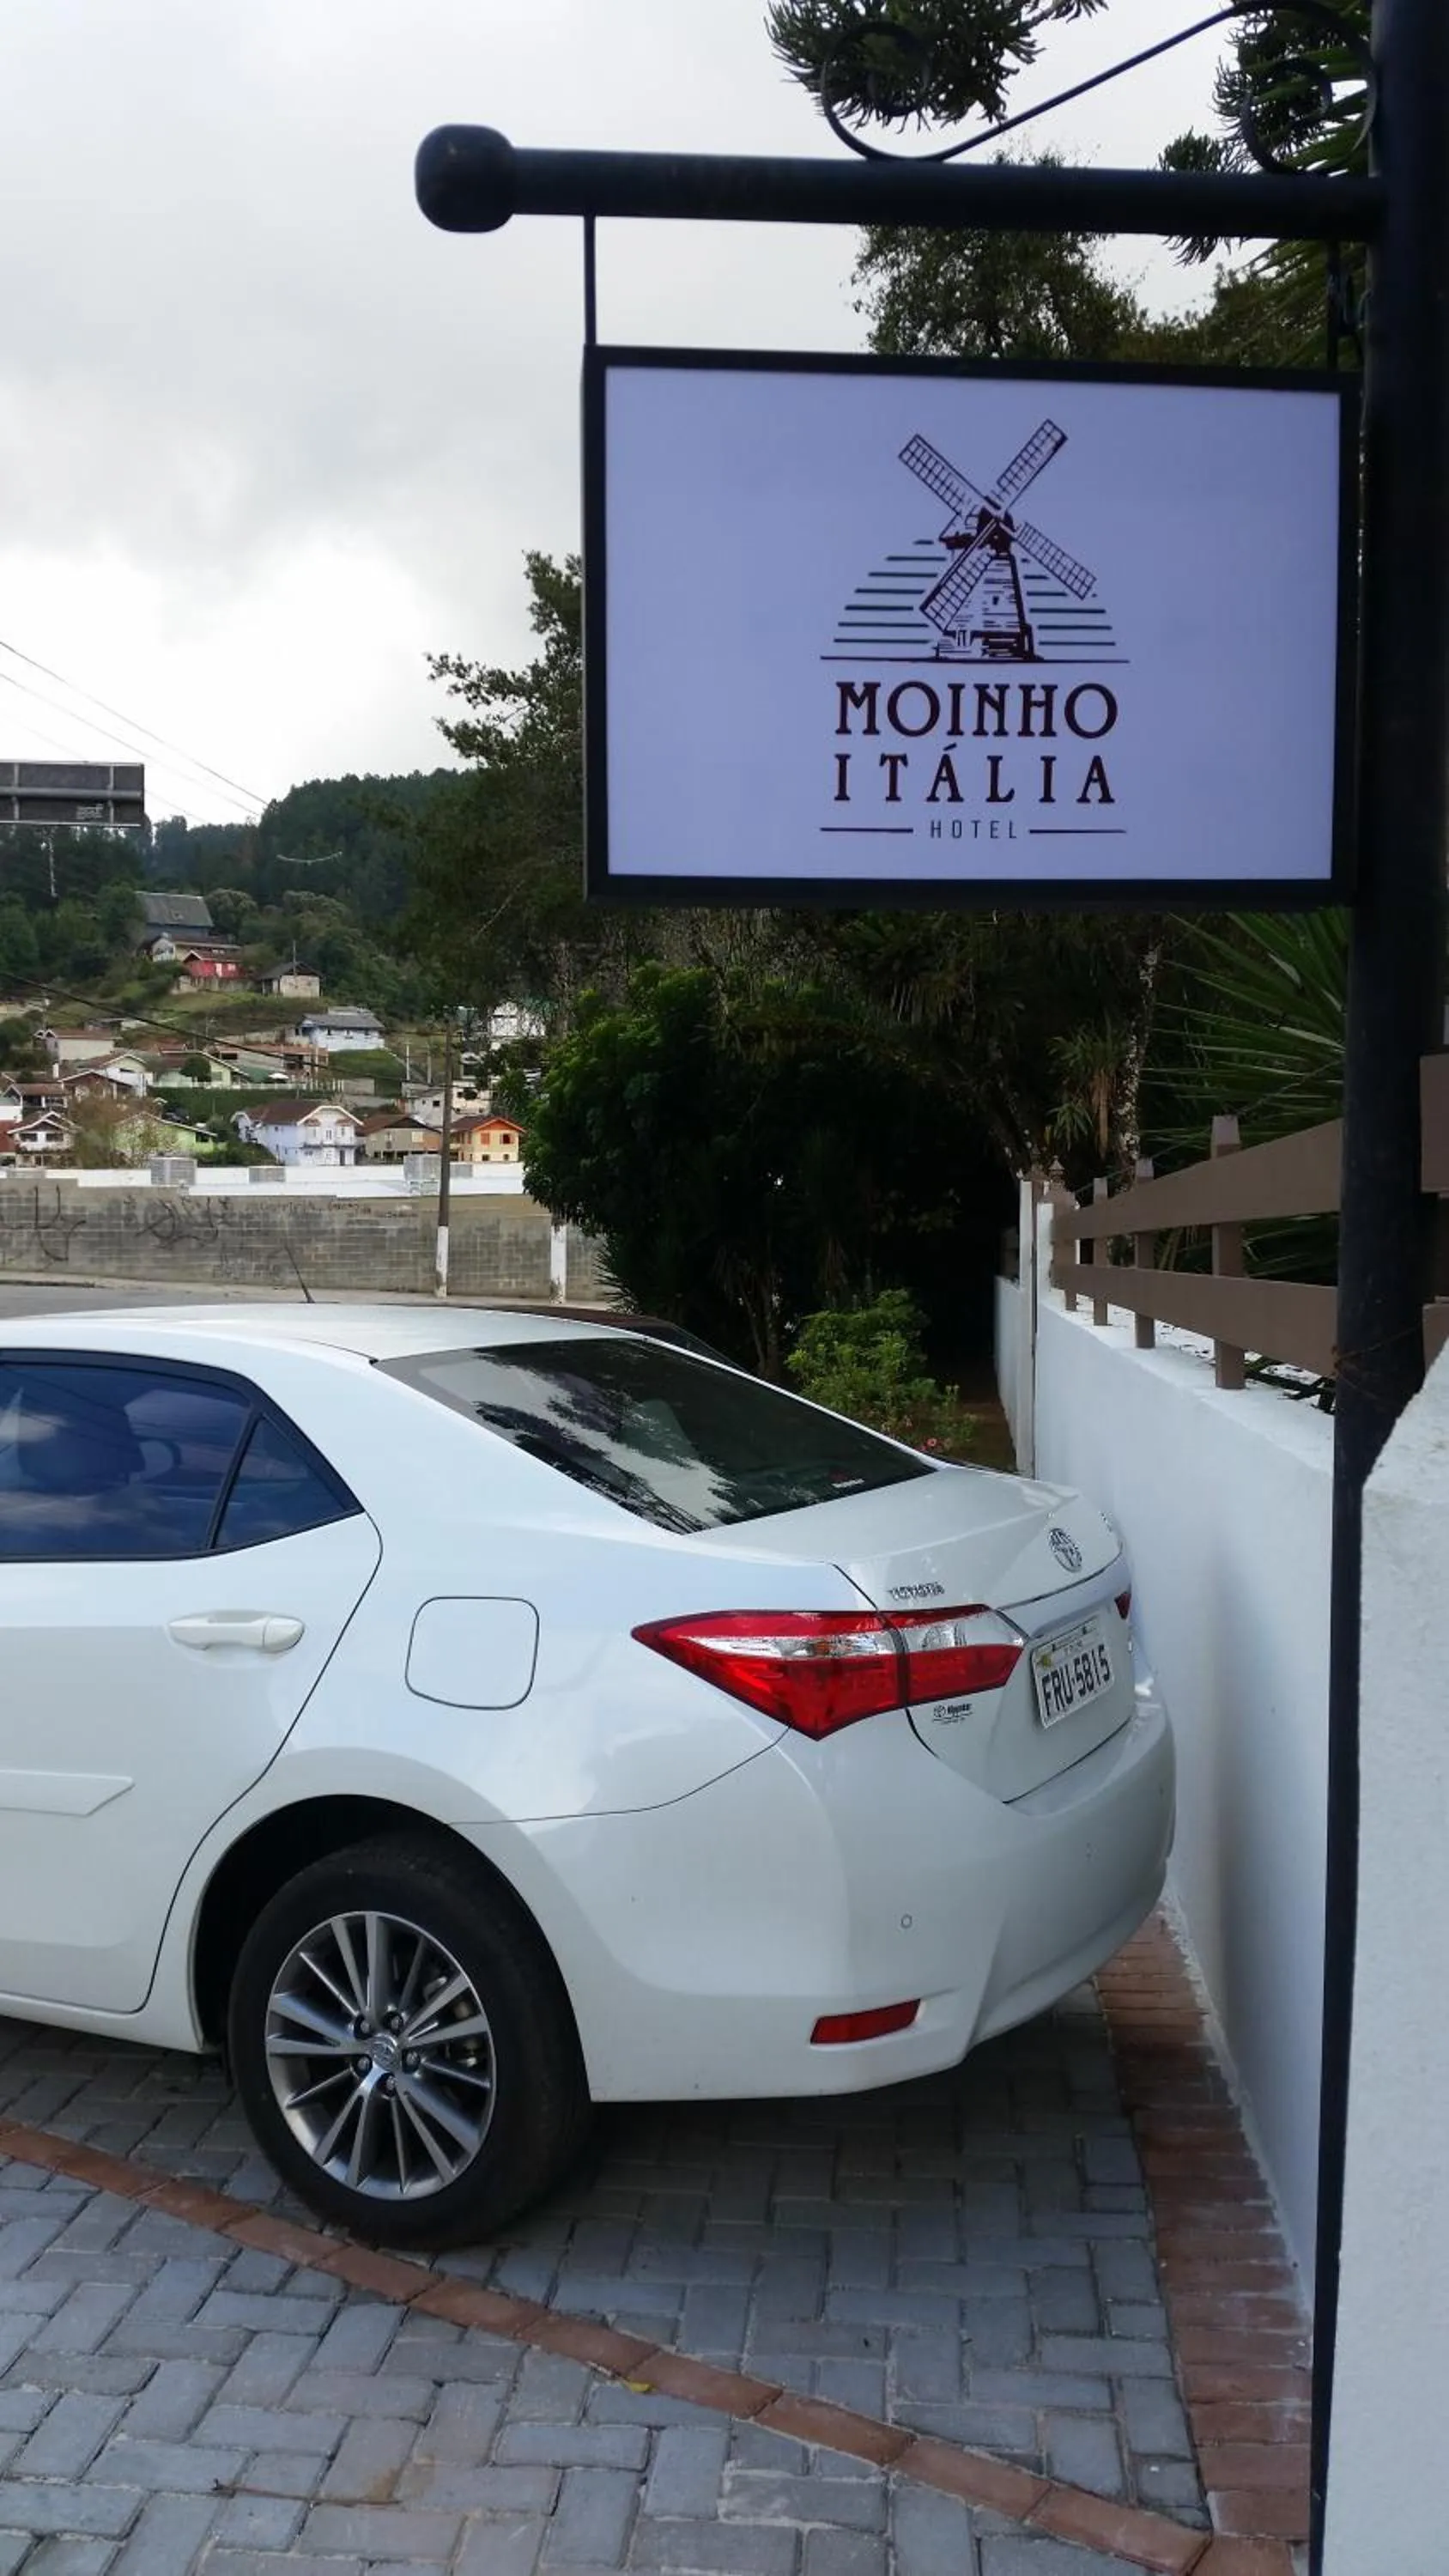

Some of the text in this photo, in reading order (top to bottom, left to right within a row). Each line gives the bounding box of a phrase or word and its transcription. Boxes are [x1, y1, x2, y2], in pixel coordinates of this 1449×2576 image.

[834, 681, 1119, 738] MOINHO
[834, 743, 1116, 804] ITÁLIA
[930, 819, 1018, 839] HOTEL
[1040, 1643, 1111, 1716] FRU-5815
